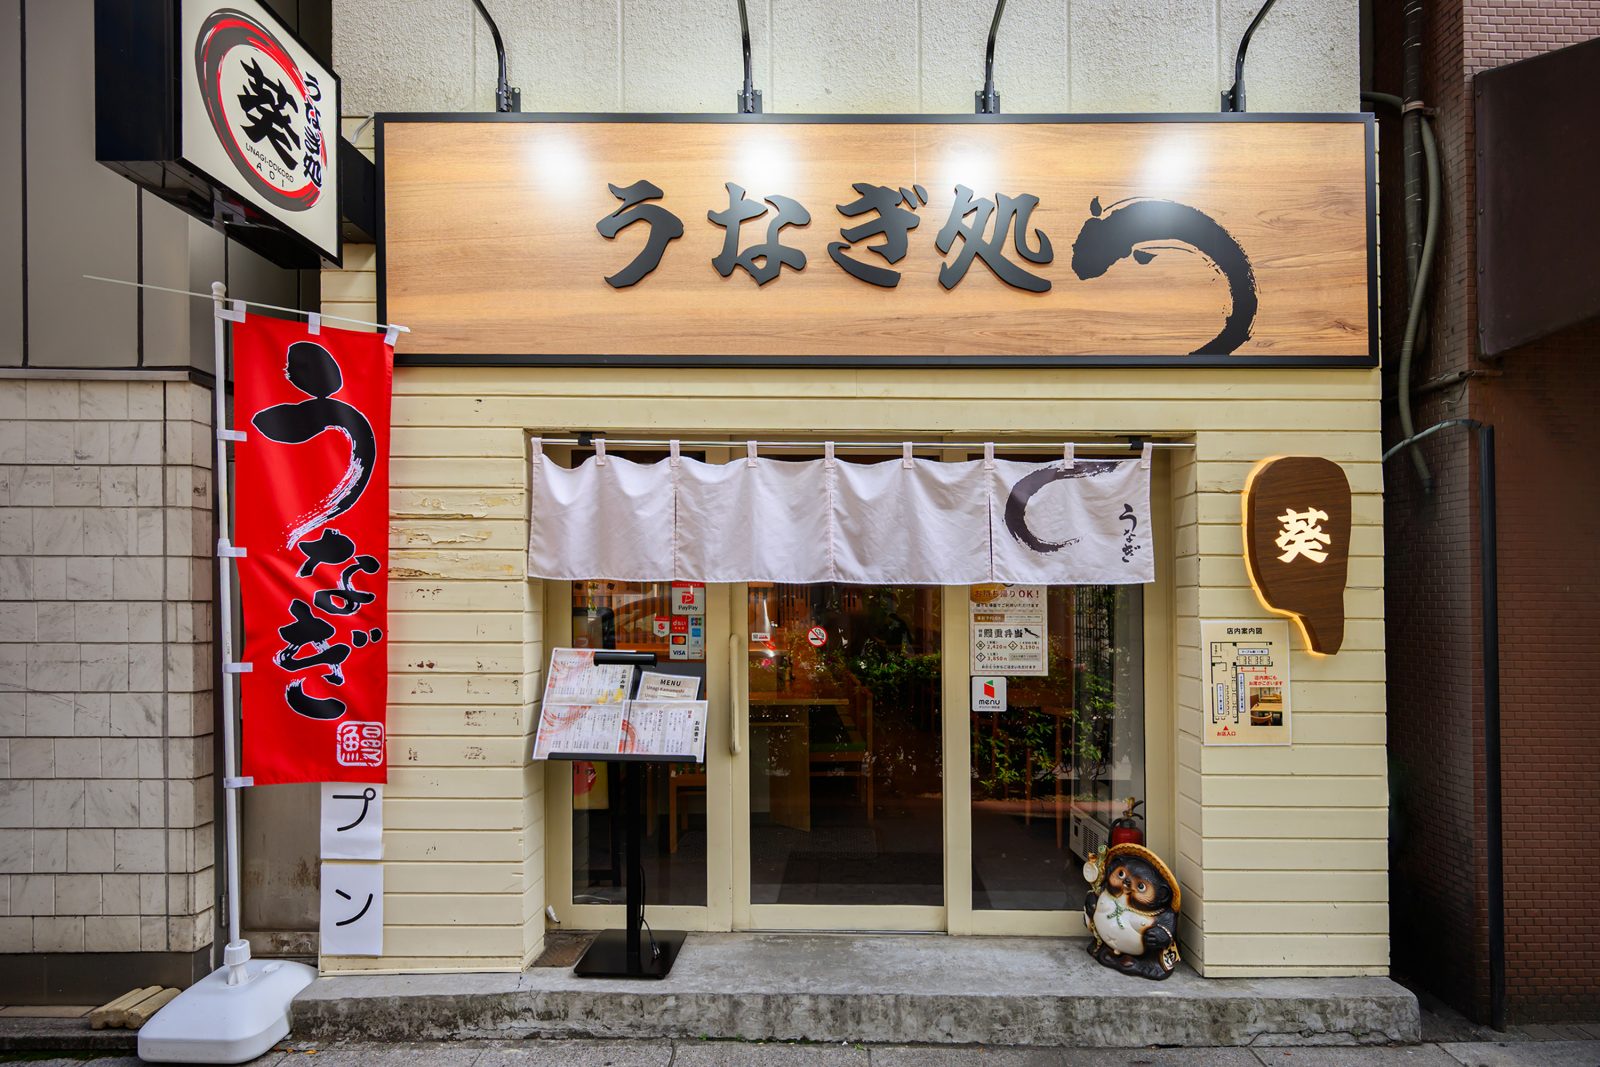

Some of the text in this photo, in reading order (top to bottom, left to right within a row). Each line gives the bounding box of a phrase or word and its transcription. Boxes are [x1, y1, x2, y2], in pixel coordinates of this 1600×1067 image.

[237, 57, 301, 170] 葵
[303, 71, 323, 188] うなぎ処
[245, 142, 294, 183] UNAGI-DOKORO
[596, 179, 1052, 294] うなぎ処
[251, 341, 383, 720] うなぎ
[1118, 503, 1141, 563] うなぎ
[1274, 506, 1332, 564] 葵
[1226, 627, 1263, 635] 店内案内図
[660, 679, 682, 687] MENU
